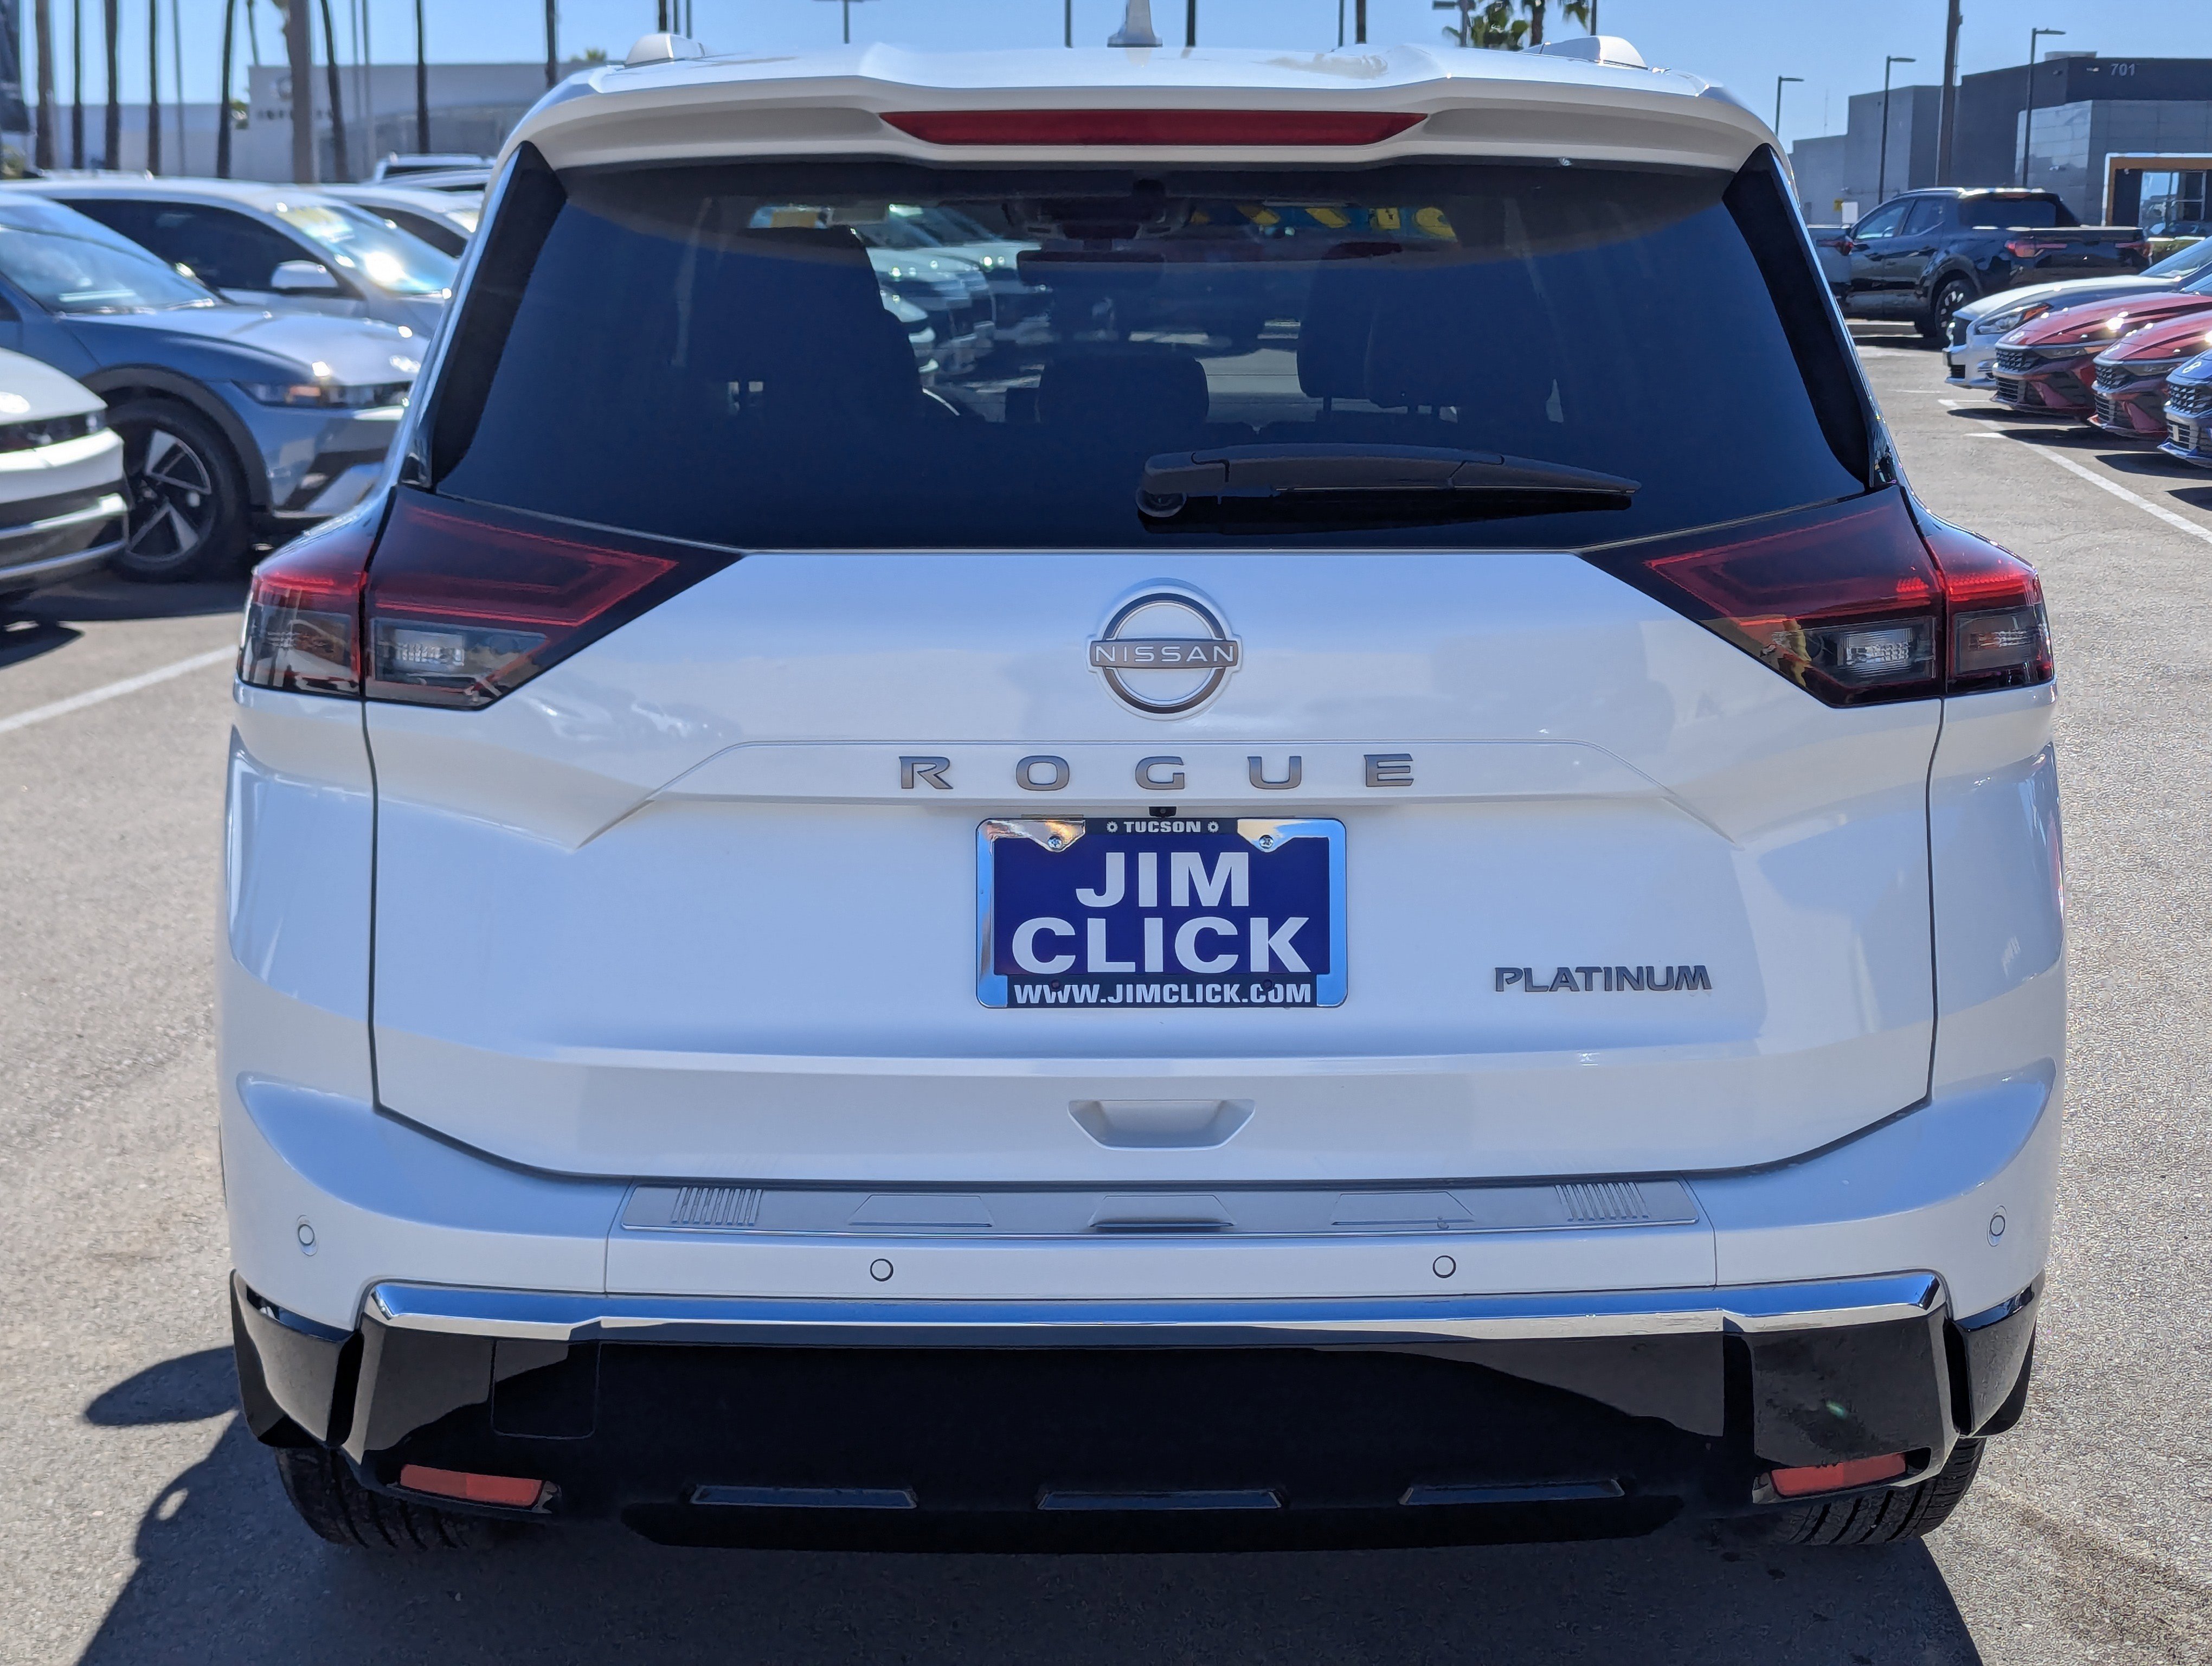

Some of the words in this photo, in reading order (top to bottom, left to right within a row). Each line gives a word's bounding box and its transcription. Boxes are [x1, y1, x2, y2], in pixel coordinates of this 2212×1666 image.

[2110, 63, 2136, 76] 701
[1095, 645, 1235, 663] NISSAN
[898, 754, 1414, 790] ROGUE
[1123, 821, 1201, 833] TUCSON
[1076, 852, 1250, 907] JIM
[1012, 917, 1311, 974] CLICK
[1495, 965, 1712, 992] PLATINUM
[1014, 984, 1311, 1003] WWW.JIMCLICK.COM
